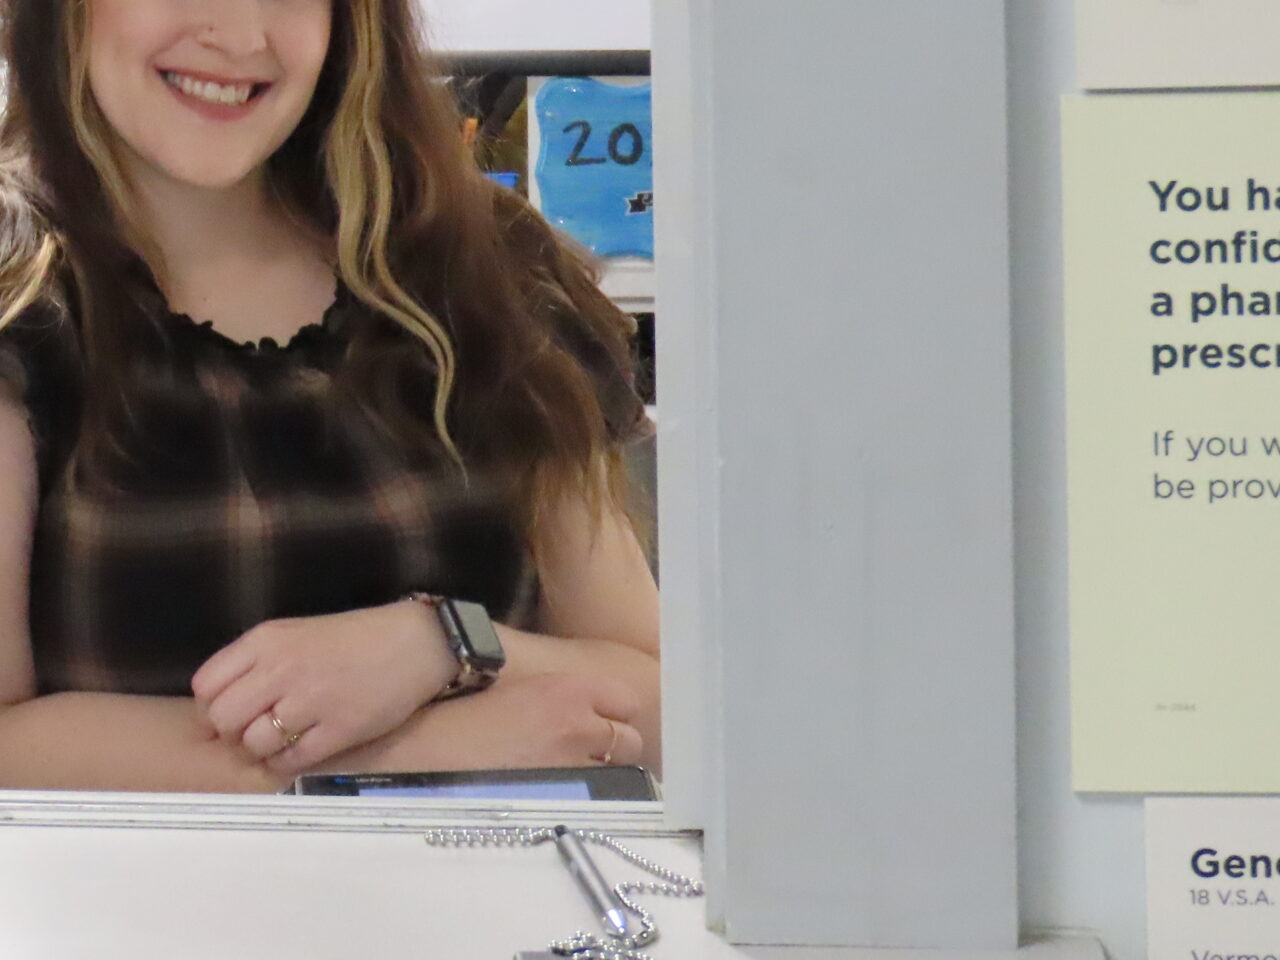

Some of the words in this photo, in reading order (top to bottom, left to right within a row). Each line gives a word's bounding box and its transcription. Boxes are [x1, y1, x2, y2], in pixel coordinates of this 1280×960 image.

[1147, 180, 1229, 212] You
[1247, 177, 1280, 211] h
[1150, 291, 1173, 317] a
[1154, 430, 1174, 456] If
[1186, 436, 1248, 462] you
[1154, 472, 1195, 499] be
[1191, 848, 1280, 878] Gen
[1190, 889, 1210, 906] 18
[1217, 889, 1277, 907] V.S.A.
